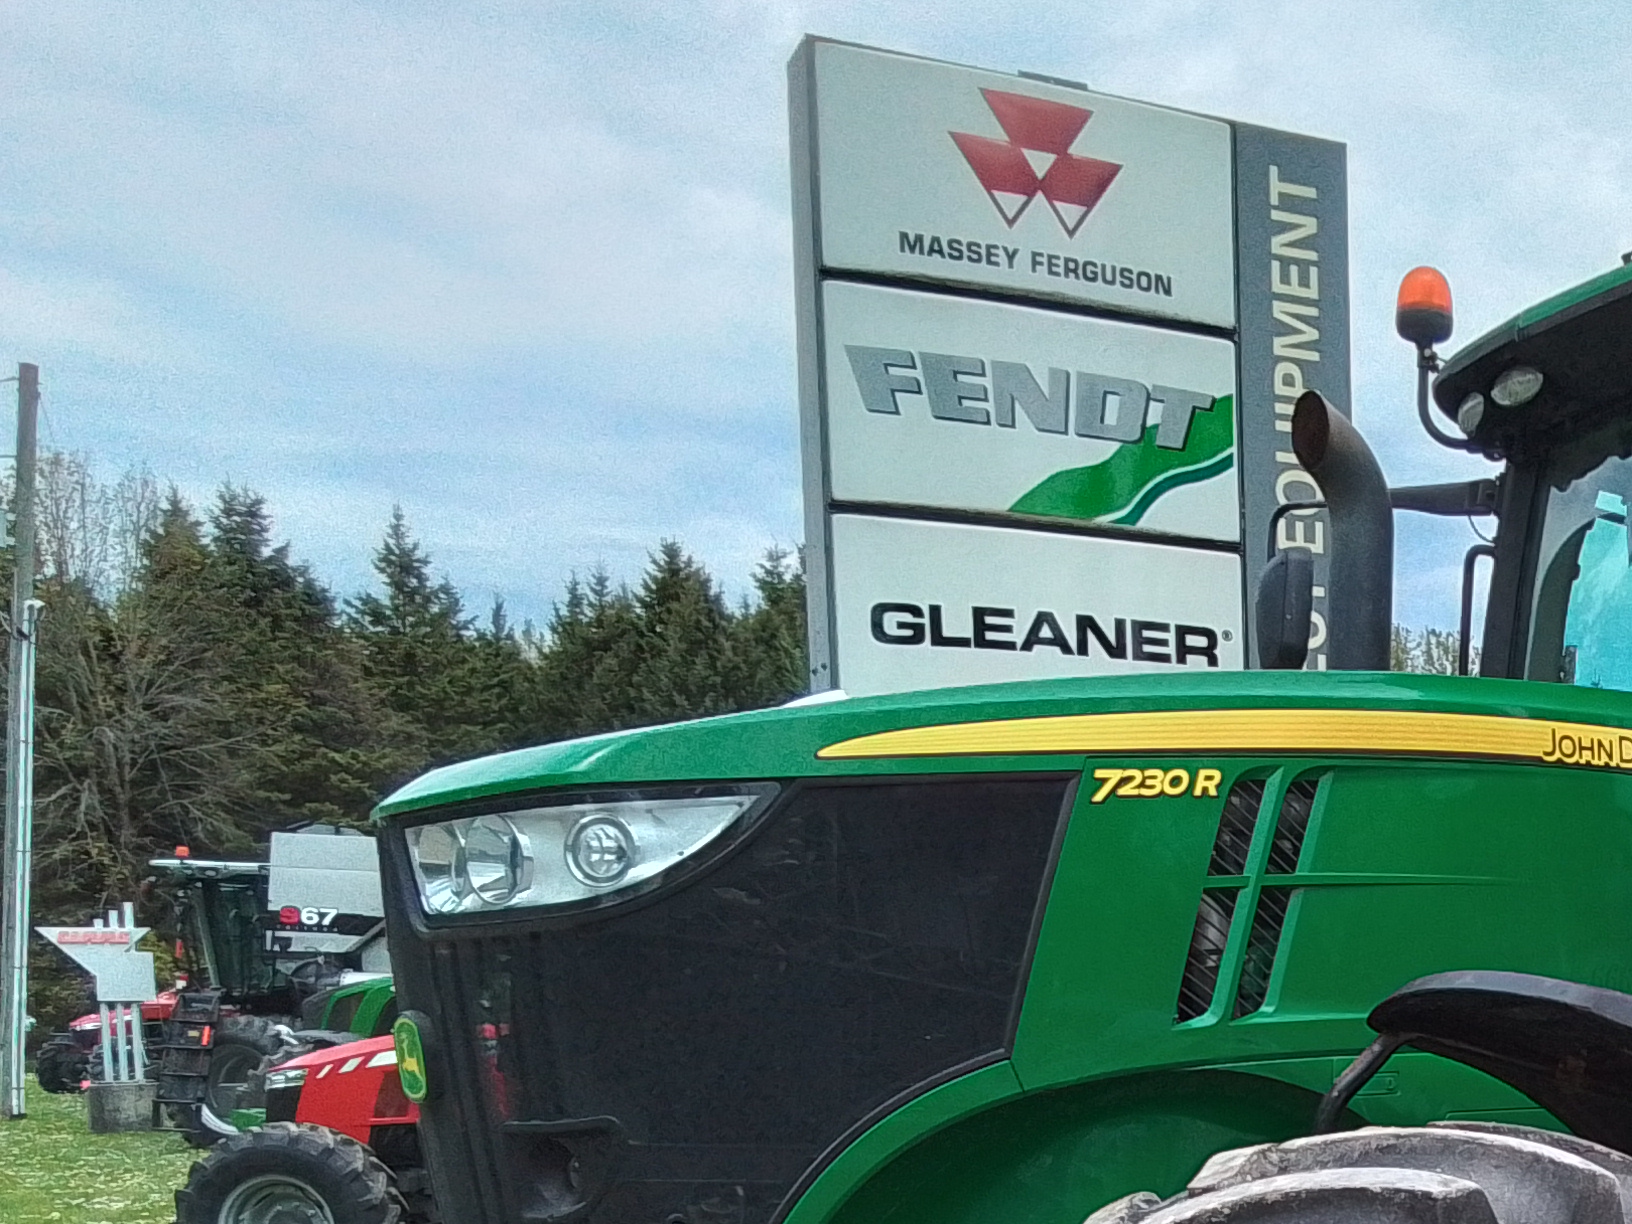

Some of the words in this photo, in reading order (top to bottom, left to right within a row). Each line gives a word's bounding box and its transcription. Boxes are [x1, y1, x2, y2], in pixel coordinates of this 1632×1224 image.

[898, 231, 1020, 269] MASSEY
[1031, 250, 1172, 297] FERGUSON
[844, 344, 1216, 451] FENDT
[1542, 728, 1614, 761] JOHN
[1090, 768, 1190, 804] 7230
[1193, 768, 1222, 797] R
